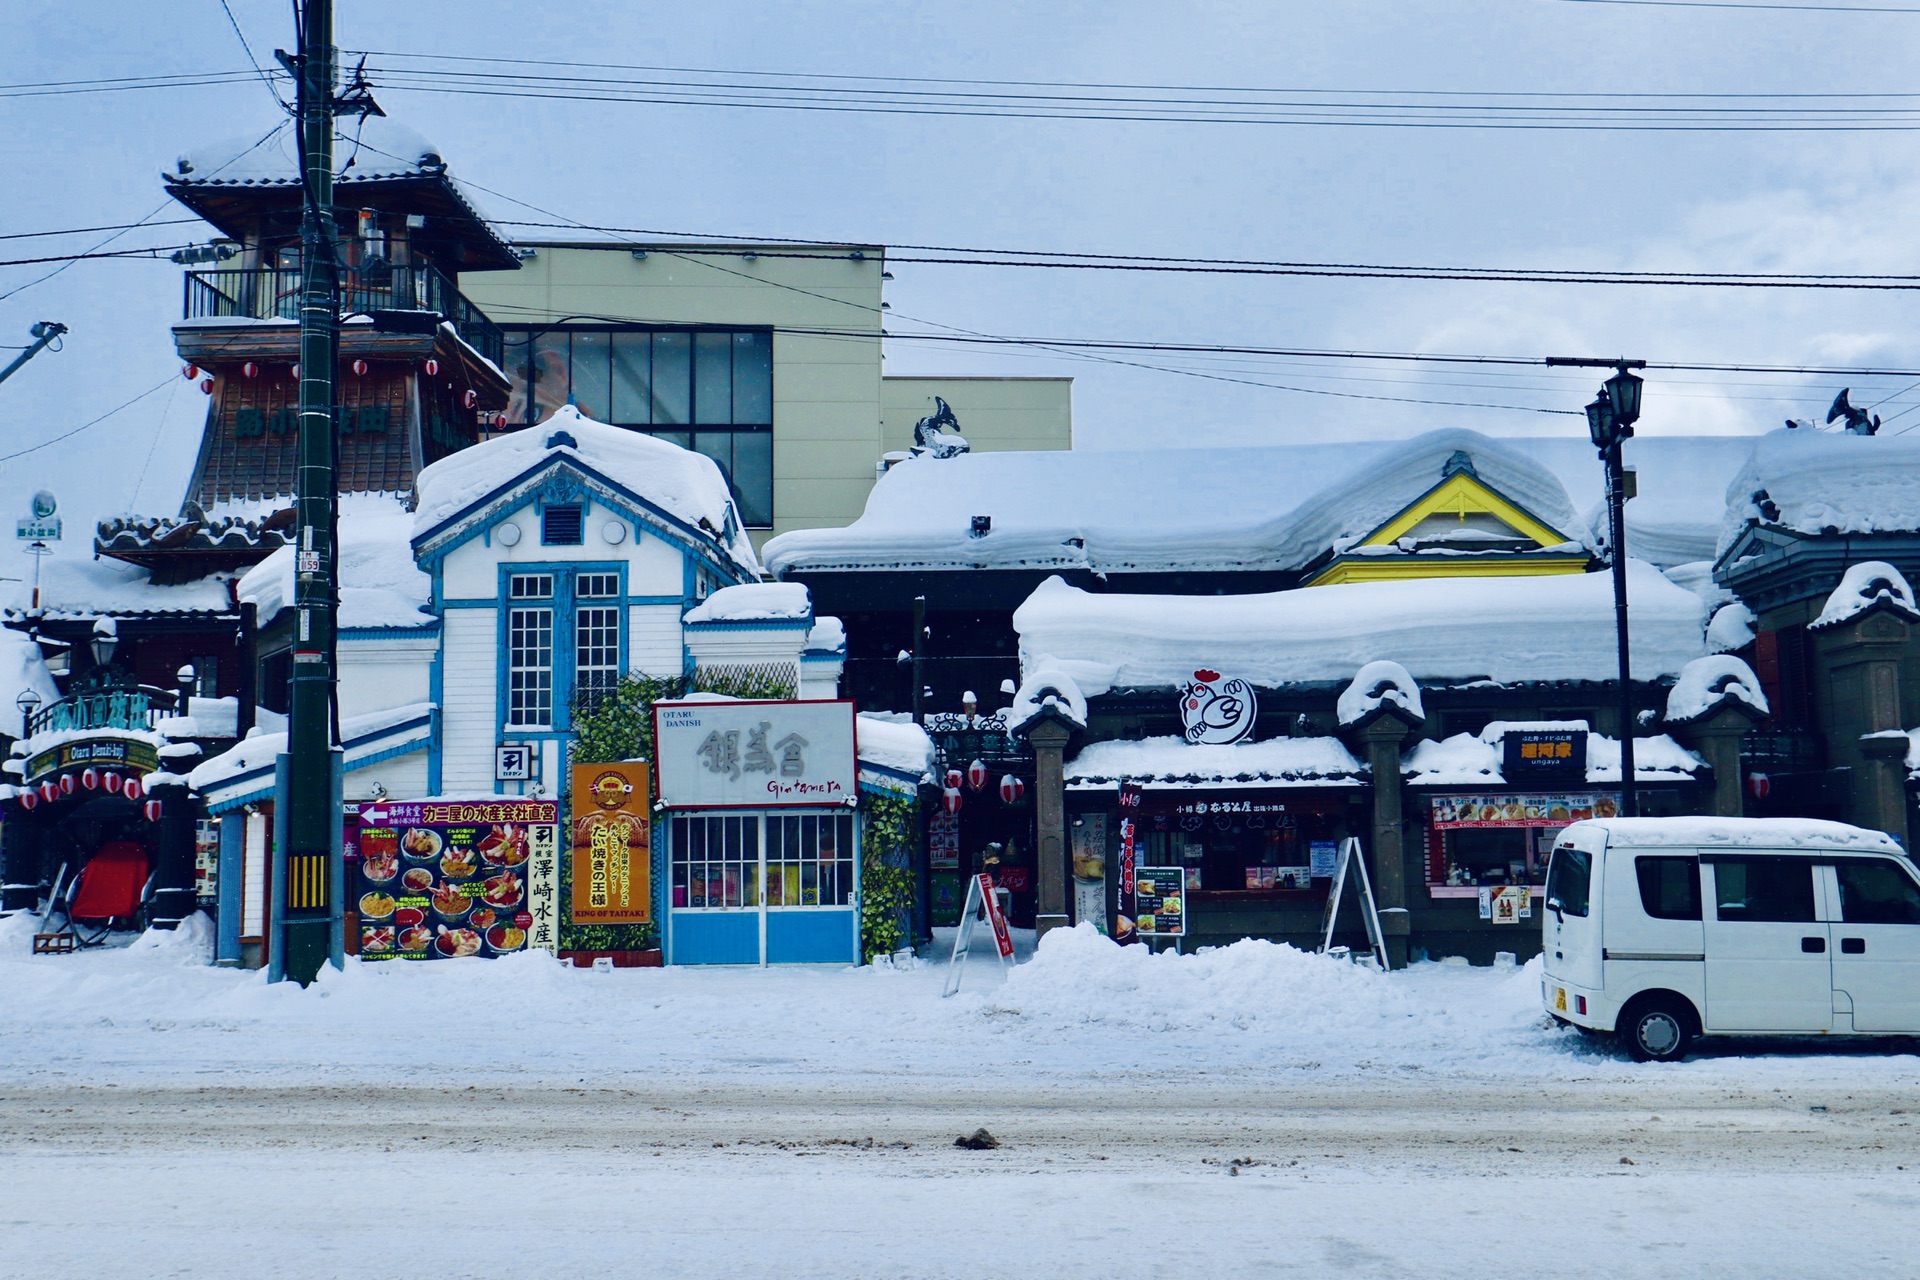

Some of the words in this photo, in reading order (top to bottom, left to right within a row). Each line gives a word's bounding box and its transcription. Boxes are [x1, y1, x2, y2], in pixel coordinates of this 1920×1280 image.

[665, 719, 702, 728] DANISH
[71, 746, 91, 760] Otaru
[388, 805, 421, 817] 海鮮食堂
[422, 804, 556, 823] カニ屋の水産会社直営
[591, 824, 607, 907] たい焼きの王様
[533, 859, 554, 944] 澤崎水産
